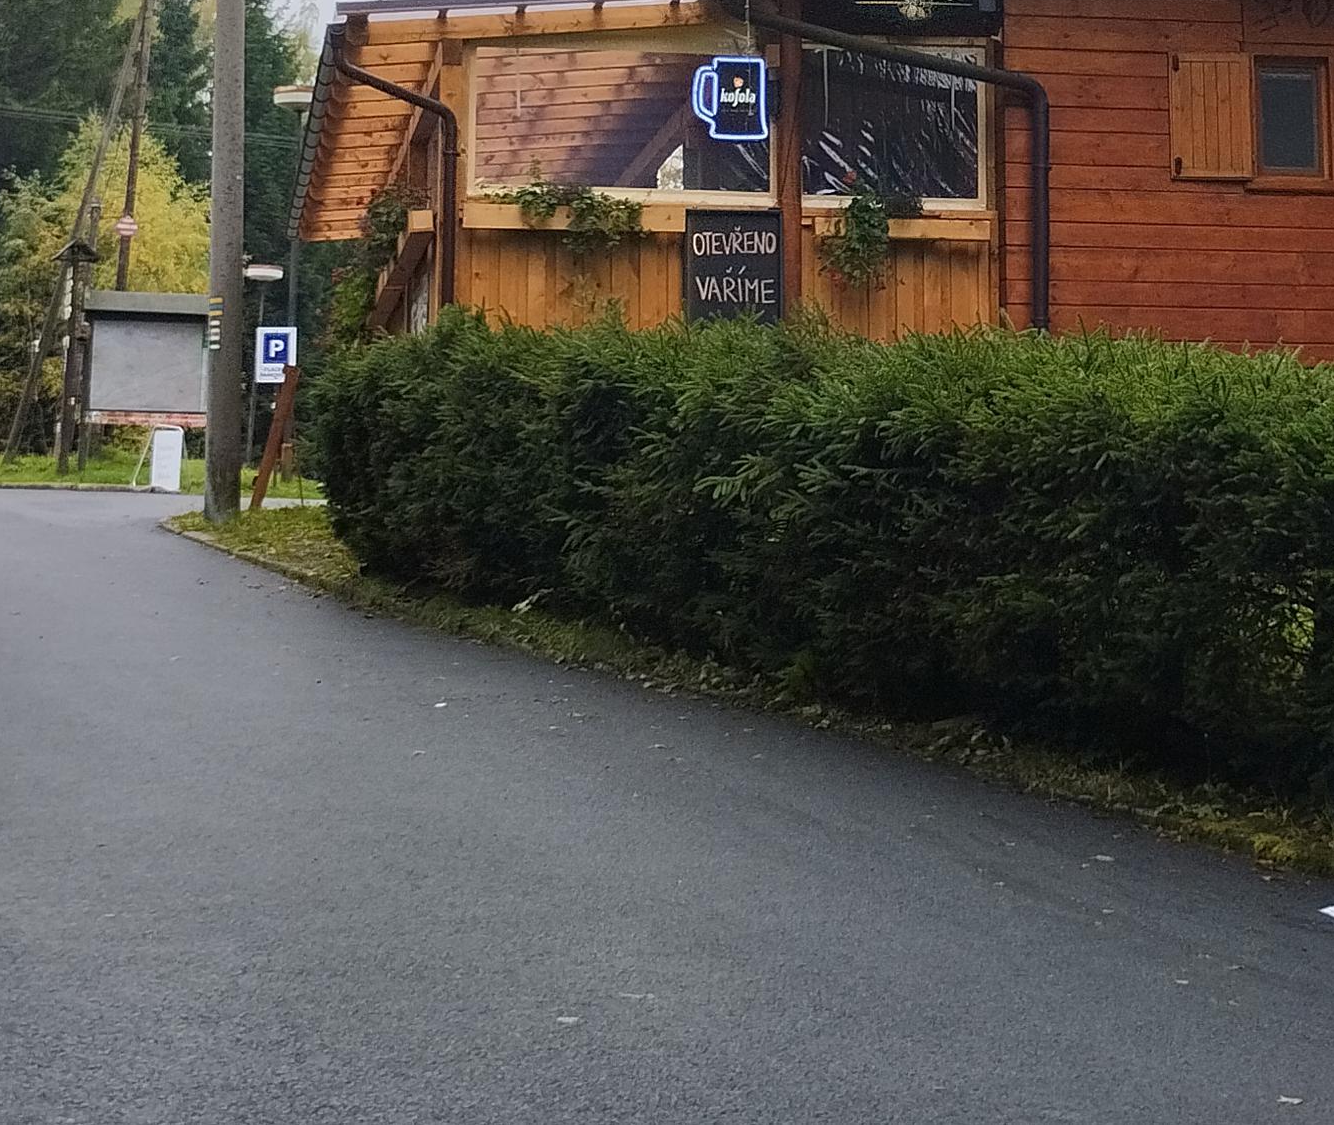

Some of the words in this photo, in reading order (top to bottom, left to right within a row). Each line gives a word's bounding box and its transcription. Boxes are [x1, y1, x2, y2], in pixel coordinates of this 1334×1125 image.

[720, 87, 756, 107] kofola
[693, 225, 777, 256] OTEVŘENO
[695, 265, 776, 304] VAŘÍME
[269, 339, 285, 358] P
